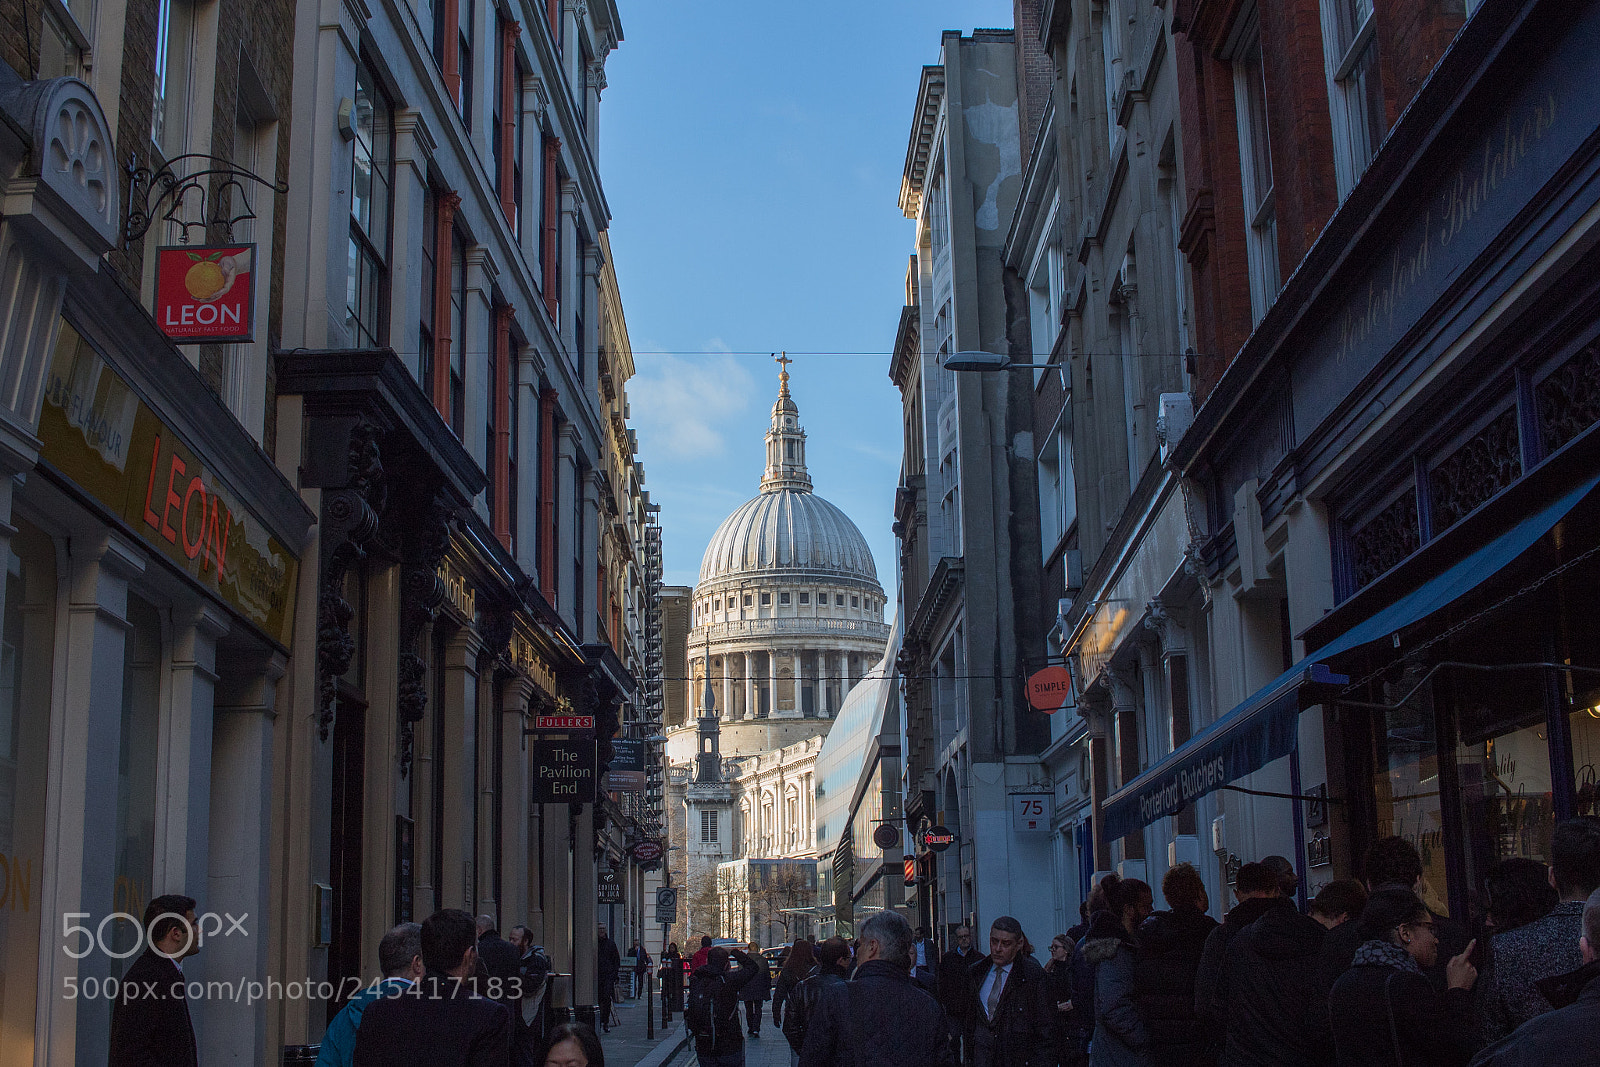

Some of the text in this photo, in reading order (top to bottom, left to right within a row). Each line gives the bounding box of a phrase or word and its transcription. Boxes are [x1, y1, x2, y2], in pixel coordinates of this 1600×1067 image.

[1440, 95, 1556, 247] Butchers
[166, 303, 240, 325] LEON
[72, 394, 122, 459] FLAVOUR
[143, 433, 232, 585] LEON
[1034, 681, 1066, 693] SIMPLE
[552, 749, 578, 762] The
[540, 765, 591, 778] Pavilion
[552, 781, 577, 794] End
[1140, 756, 1224, 821] Porterford Butchers
[1020, 800, 1043, 815] 75
